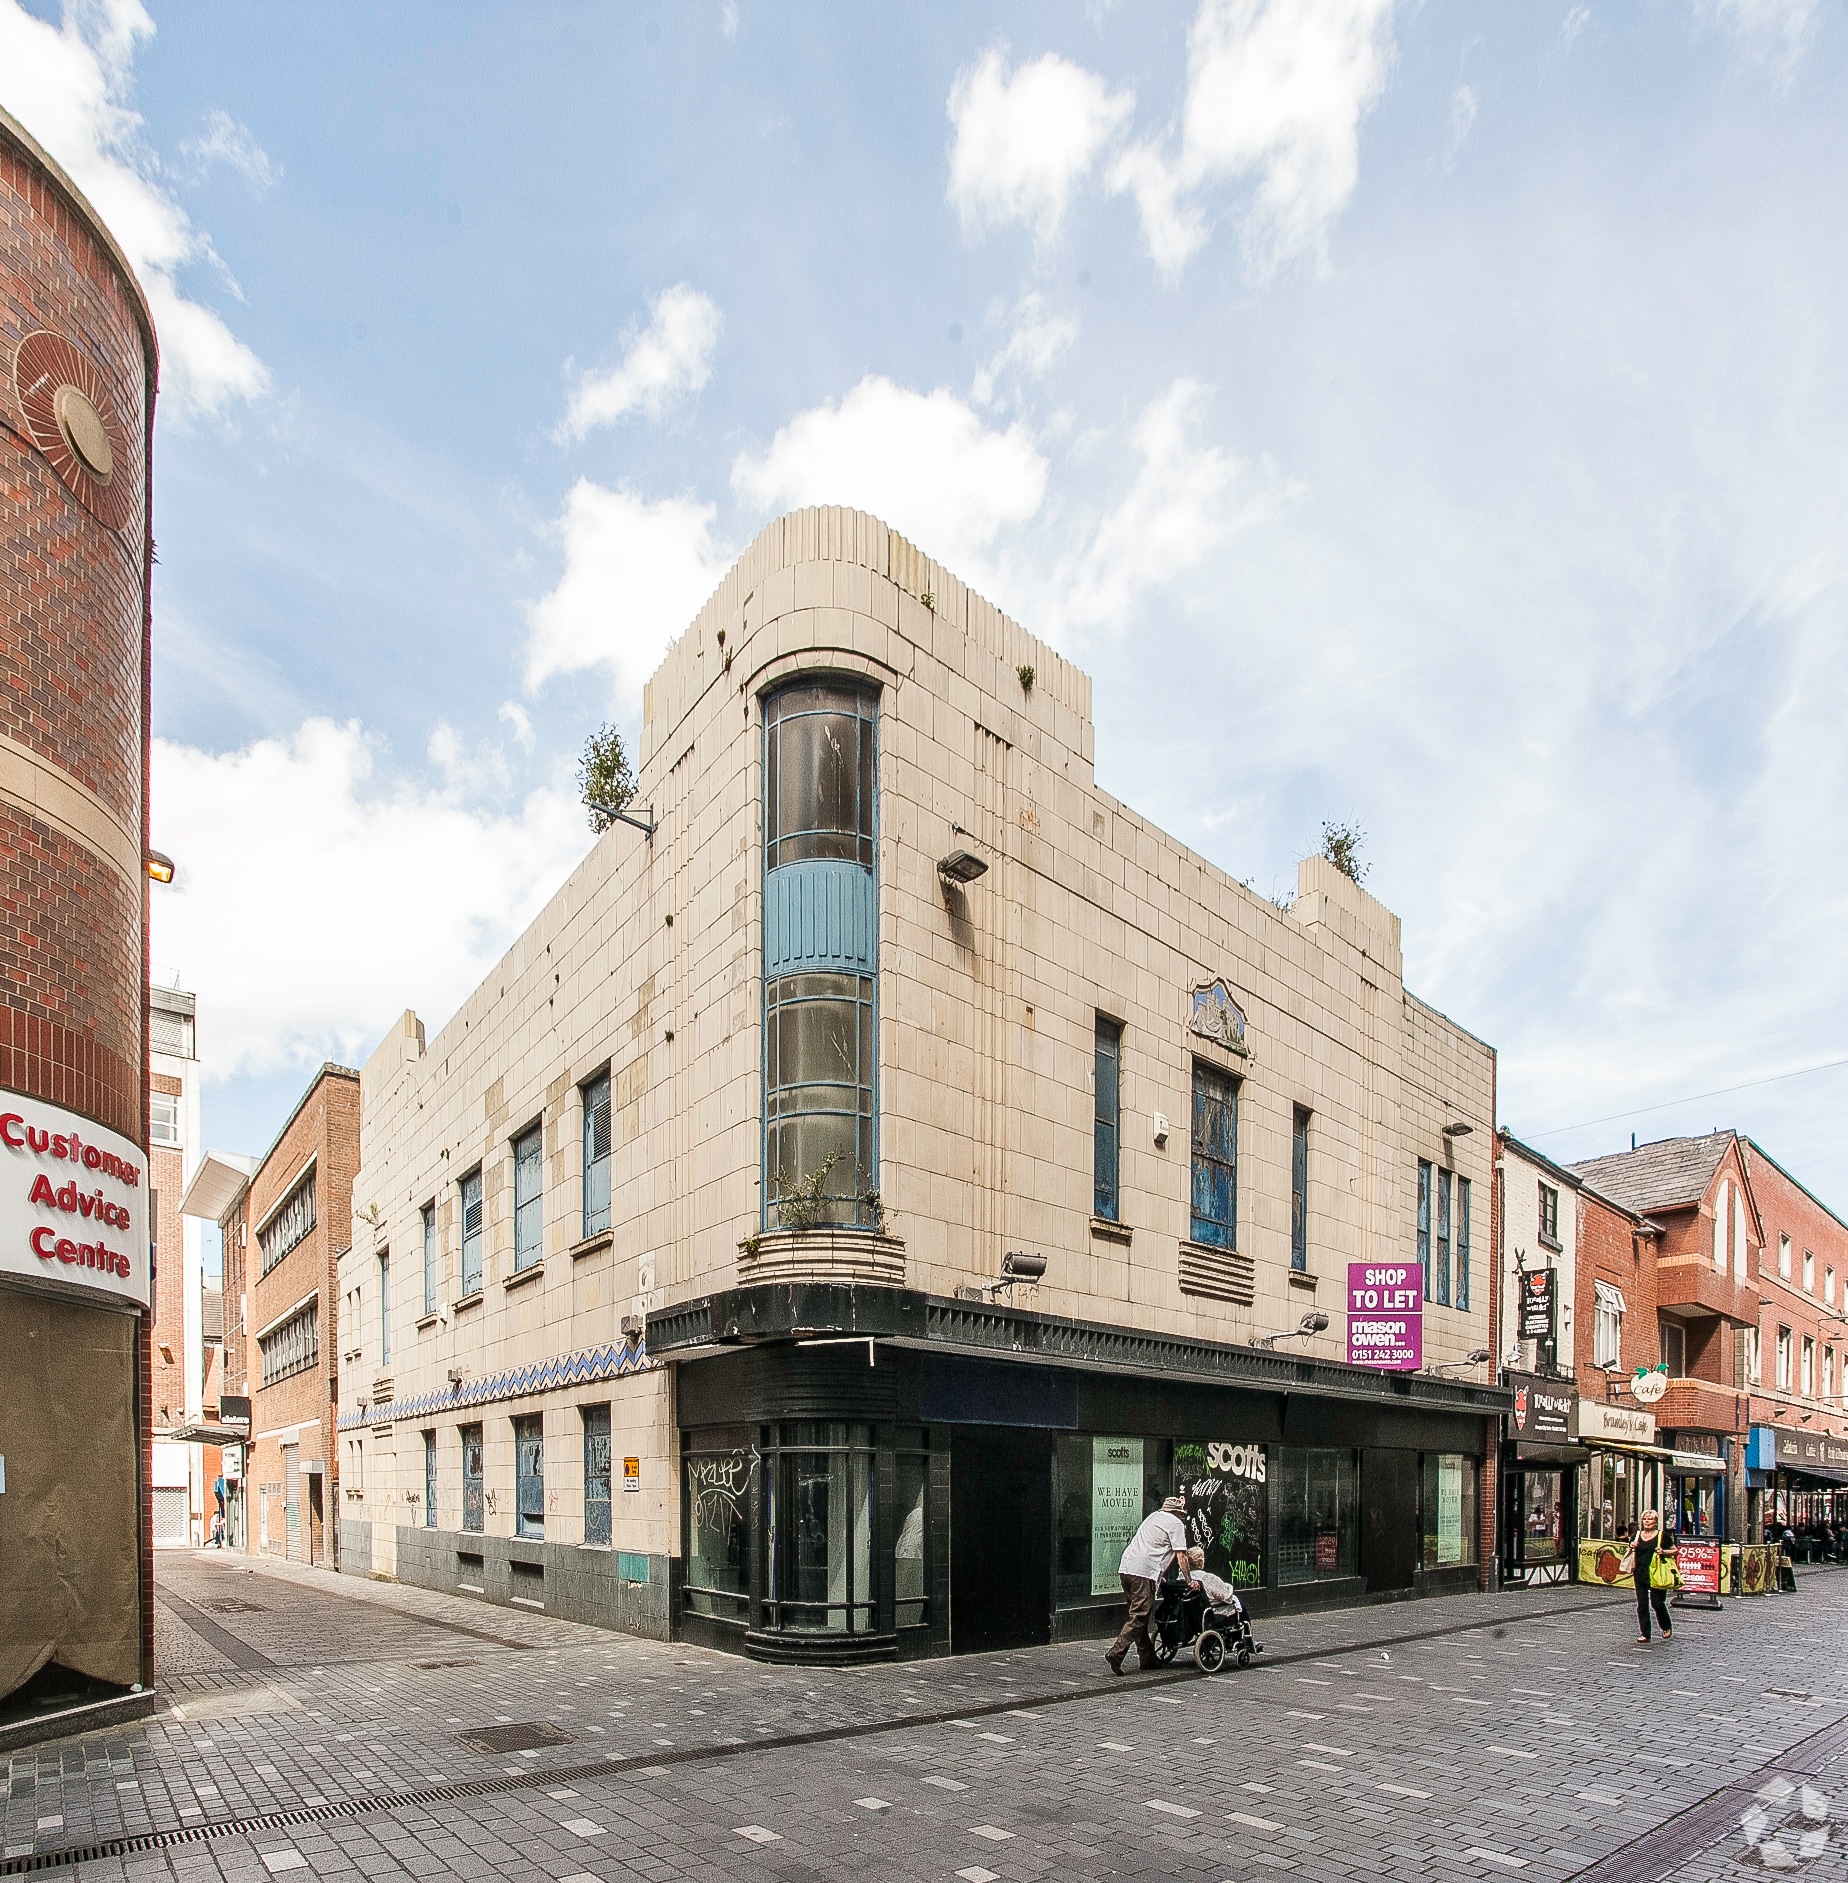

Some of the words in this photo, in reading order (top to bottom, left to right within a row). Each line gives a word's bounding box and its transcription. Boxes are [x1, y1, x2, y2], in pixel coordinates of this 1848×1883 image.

[0, 1112, 141, 1188] Customer
[29, 1173, 131, 1231] Advice
[30, 1226, 131, 1279] Centre
[1364, 1268, 1407, 1286] SHOP
[1352, 1289, 1379, 1309] TO
[1383, 1289, 1418, 1309] LET
[1351, 1321, 1407, 1334] mason
[1352, 1349, 1372, 1360] 0151
[1373, 1349, 1391, 1360] 242
[1391, 1349, 1414, 1360] 3000
[1107, 1446, 1130, 1459] scotts
[1207, 1442, 1266, 1483] scotts
[1097, 1486, 1112, 1497] WE
[1114, 1487, 1139, 1497] HAVE
[1101, 1498, 1134, 1508] MOVED
[1680, 1547, 1708, 1559] 95%
